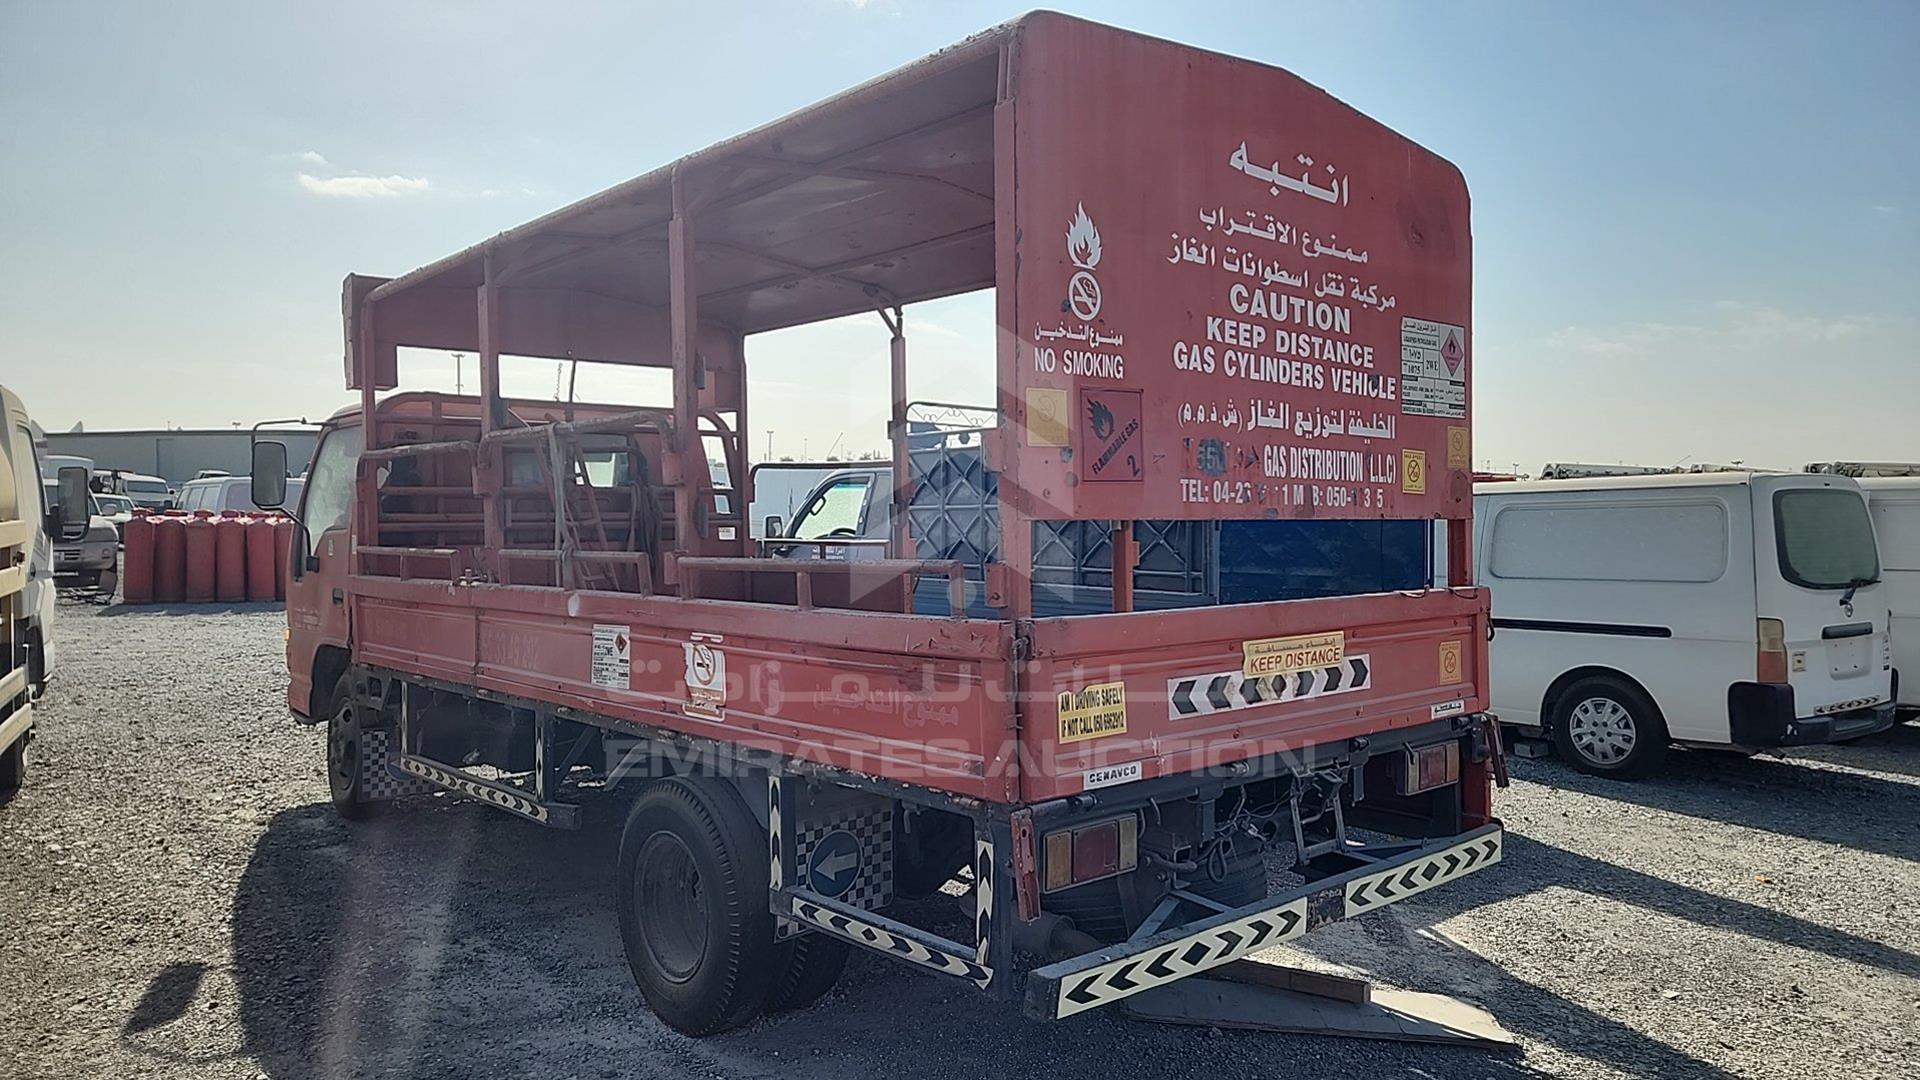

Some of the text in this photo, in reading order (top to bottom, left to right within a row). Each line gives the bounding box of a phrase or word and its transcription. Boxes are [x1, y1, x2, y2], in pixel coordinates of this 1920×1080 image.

[1229, 140, 1349, 207] انتبه
[1199, 205, 1368, 263] ممنوع الاقتراب
[1167, 232, 1396, 311] مركبة نقل اسطوانات الغاز
[1230, 283, 1350, 334] CAUTION
[1034, 321, 1123, 349] ممنوع التدخين
[1206, 316, 1374, 368] KEEP DISTANCE
[1034, 347, 1124, 379] NO SMOKING
[1173, 341, 1396, 400] GAS CYLINDERS VEHICLE
[1247, 399, 1289, 431] الغاز
[1294, 407, 1345, 439] لتوزيع
[1348, 408, 1396, 444] الخليفة
[1092, 418, 1139, 475] FLAMMABLE GAS
[1263, 444, 1287, 478] GAS
[1290, 447, 1363, 482] DISTRIBUTION
[1127, 455, 1141, 477] 2
[1180, 479, 1209, 502] TEL:
[1250, 647, 1341, 673] KEEP DISTANCE
[1060, 693, 1071, 712] AM
[1075, 690, 1100, 710] DRIVING
[1101, 687, 1124, 706] SAFELY
[1061, 719, 1067, 738] IF
[1067, 717, 1079, 736] NOT
[1079, 715, 1093, 735] CALL
